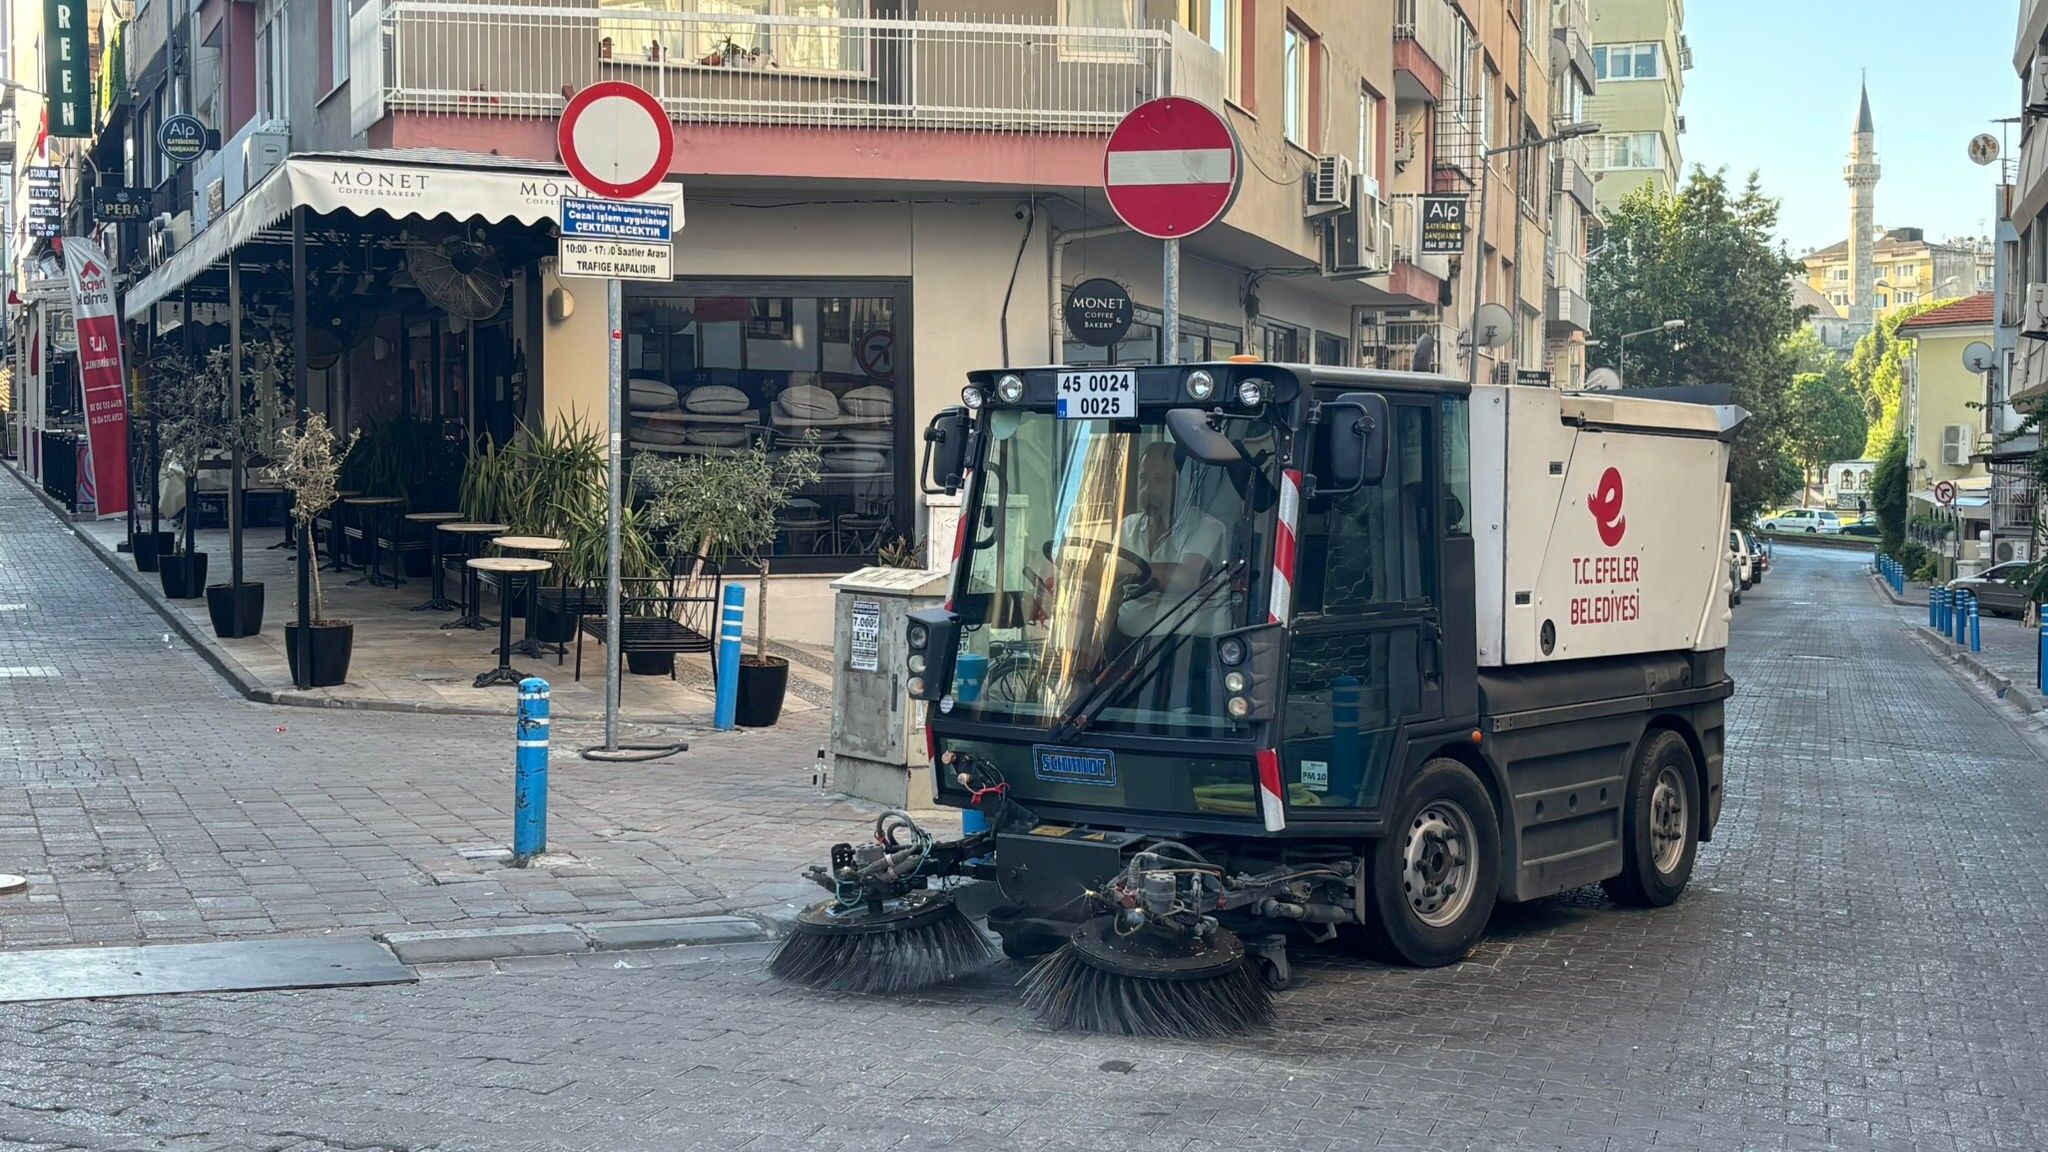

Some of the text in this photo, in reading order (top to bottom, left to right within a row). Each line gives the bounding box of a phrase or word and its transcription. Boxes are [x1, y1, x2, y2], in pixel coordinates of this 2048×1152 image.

[170, 122, 195, 139] Alp
[30, 188, 59, 198] TATTOO
[338, 186, 375, 195] COFFEE
[386, 190, 422, 198] BAKERY
[30, 207, 60, 217] PIERCING
[105, 203, 141, 215] PERA
[1429, 202, 1459, 221] Alp
[568, 210, 668, 228] Cezai işlem uygulanıp
[566, 243, 587, 254] 10:00
[617, 246, 645, 257] Saatler
[646, 248, 667, 258] Arası
[613, 263, 656, 274] KAPALIDIR
[1084, 311, 1114, 319] COFFEE
[1084, 321, 1113, 329] BAKERY
[1062, 374, 1129, 392] 45 0024
[1080, 397, 1120, 415] 0025
[1572, 557, 1639, 585] T.C. EFELER
[1570, 587, 1640, 626] BELEDİYESİ
[1041, 753, 1106, 776] SCHMIDT
